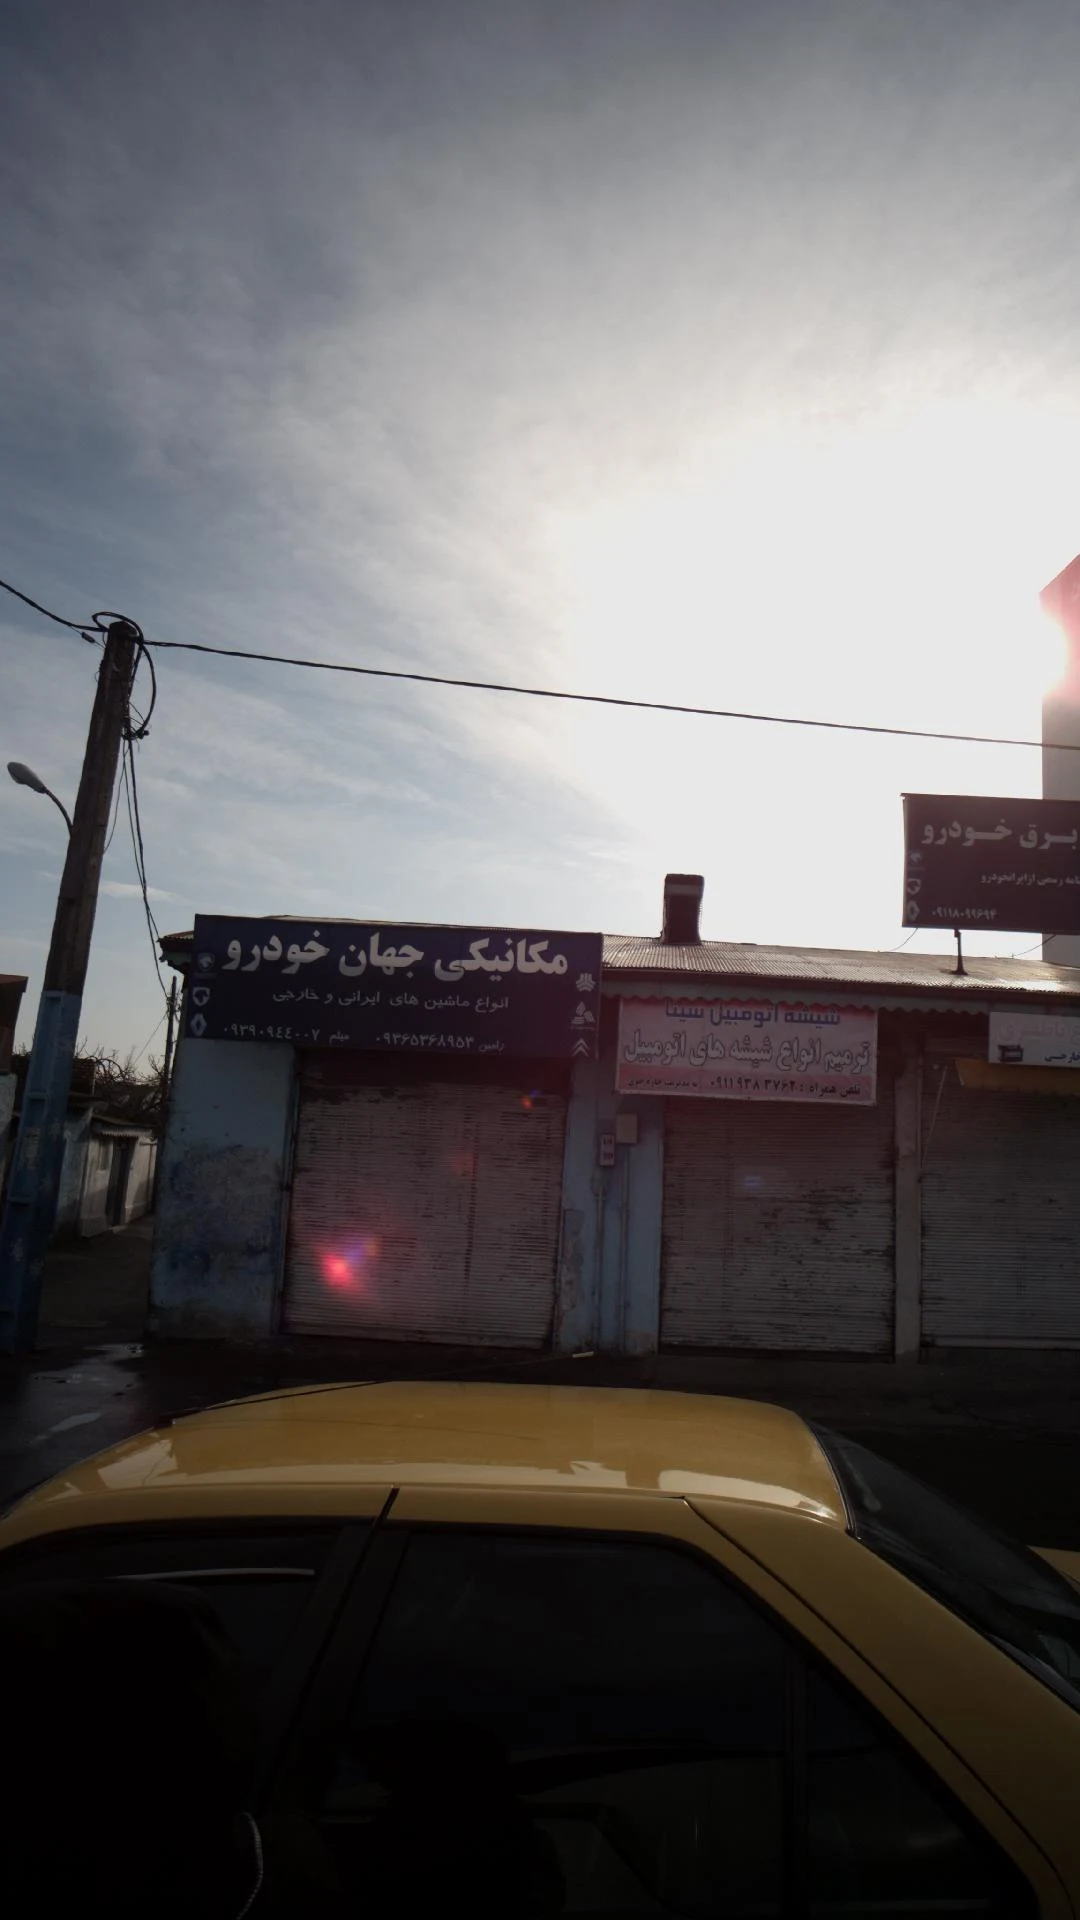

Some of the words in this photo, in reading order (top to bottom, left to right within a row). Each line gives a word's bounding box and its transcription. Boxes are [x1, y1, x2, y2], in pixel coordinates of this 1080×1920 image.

[921, 818, 1012, 847] خودرو
[1019, 824, 1078, 850] برق
[222, 930, 330, 974] خودرو
[339, 931, 424, 978] جهان
[434, 937, 568, 981] مکانیکی
[272, 988, 320, 1002] خارجی
[324, 992, 333, 1004] و
[338, 990, 380, 1006] ایرانی
[389, 992, 419, 1006] های
[424, 994, 470, 1010] ماشین
[474, 996, 509, 1013] انواع
[710, 1001, 779, 1028] اتومبیل
[785, 1006, 840, 1029] شیشه
[623, 1029, 687, 1065] اتومبیل
[689, 1032, 725, 1067] های
[729, 1036, 773, 1068] شیشه
[776, 1037, 821, 1072] انواع
[824, 1041, 871, 1074] ترمیم
[809, 1082, 837, 1097] همراه
[840, 1082, 861, 1097] تلفن
